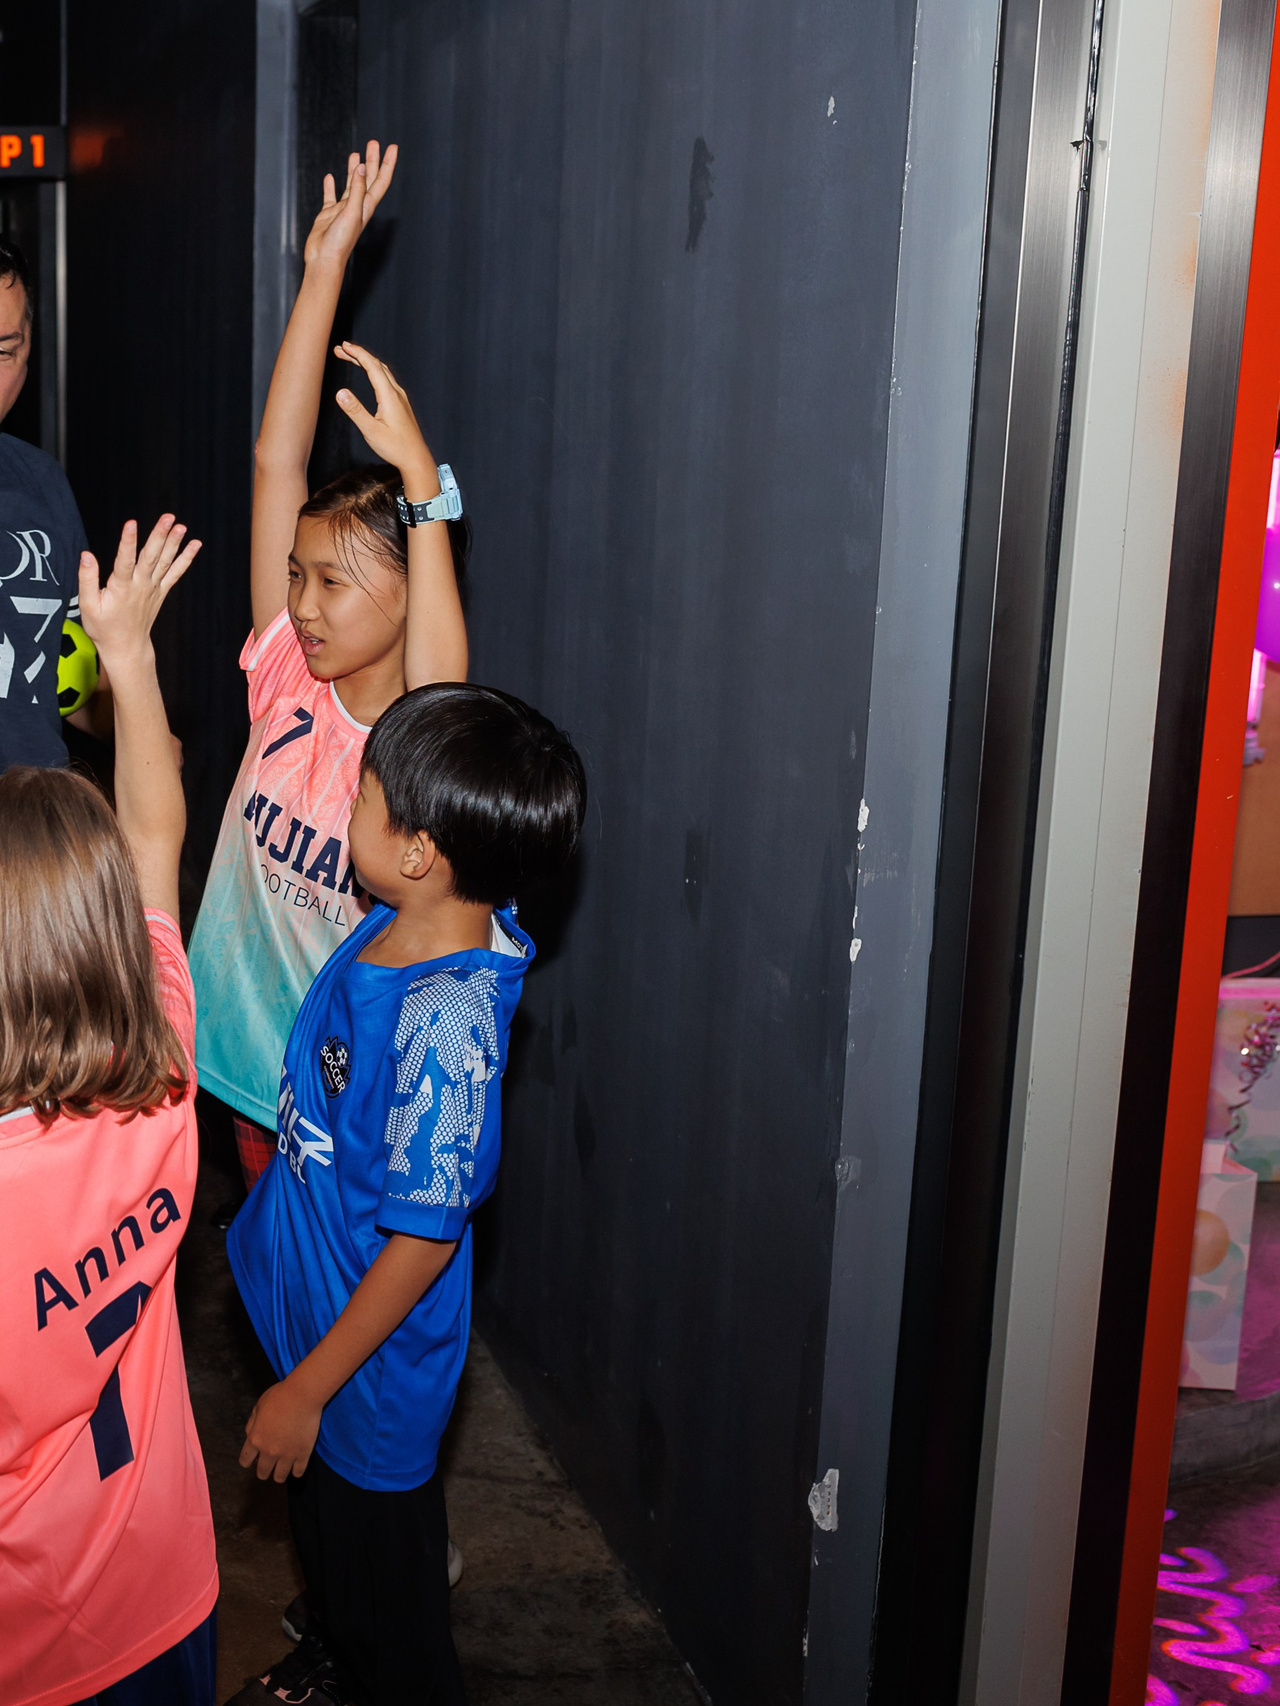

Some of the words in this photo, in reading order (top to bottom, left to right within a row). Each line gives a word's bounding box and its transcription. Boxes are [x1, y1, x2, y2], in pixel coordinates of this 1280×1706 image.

[30, 134, 45, 168] 1
[262, 706, 314, 760] 7
[320, 1045, 346, 1093] SOCCER
[33, 1186, 182, 1332] Anna
[84, 1280, 153, 1482] 7
